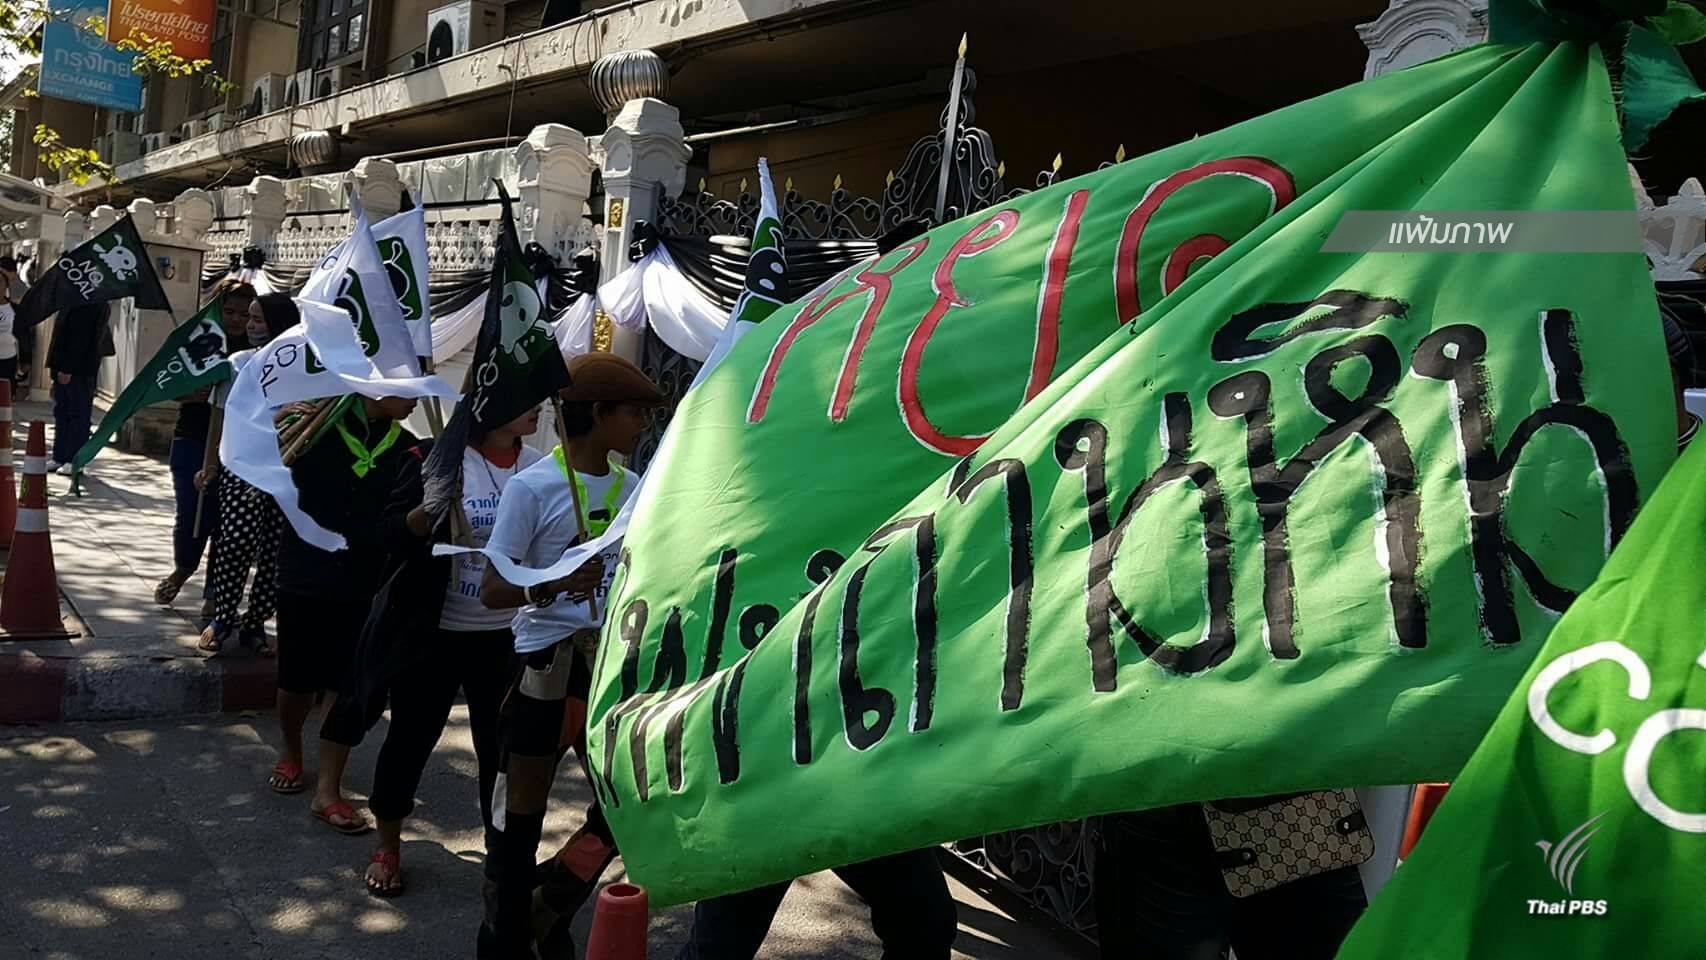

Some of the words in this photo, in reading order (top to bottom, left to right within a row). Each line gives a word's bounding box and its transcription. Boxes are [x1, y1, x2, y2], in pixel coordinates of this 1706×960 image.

[120, 16, 176, 35] THAILAND
[178, 30, 208, 43] POST
[54, 48, 131, 78] กรุงไทย
[44, 70, 114, 92] EXCHANGE
[59, 258, 95, 300] COAL
[78, 260, 104, 288] NO
[746, 156, 1297, 458] หยด
